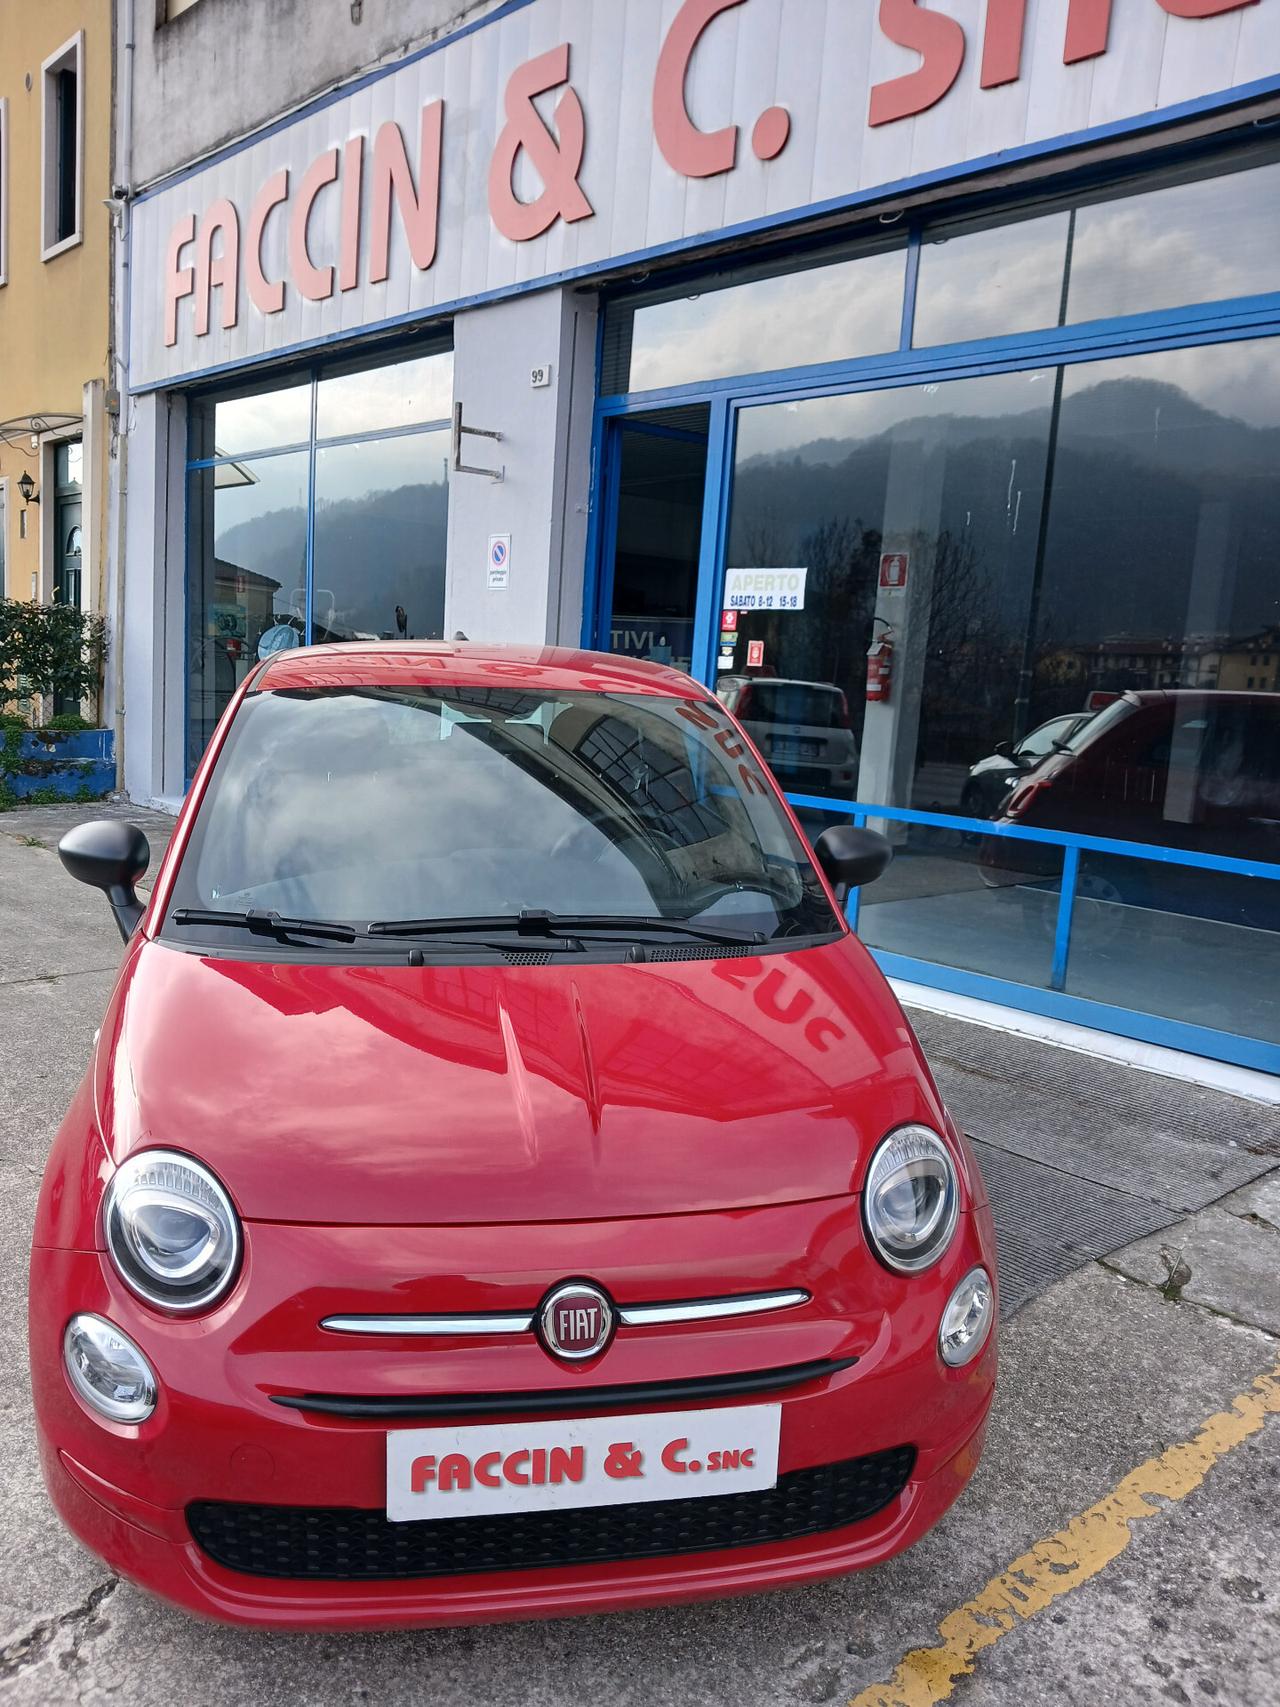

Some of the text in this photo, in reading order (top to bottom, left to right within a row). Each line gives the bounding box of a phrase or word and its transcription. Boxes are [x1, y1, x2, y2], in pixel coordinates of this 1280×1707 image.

[164, 99, 444, 347] FACCIN
[488, 42, 594, 241] &
[531, 369, 544, 383] 99
[731, 574, 799, 591] APERTO
[730, 595, 755, 607] SABATO
[560, 1308, 598, 1340] FIAT
[411, 1438, 754, 1492] FACCIN & C. SNC
